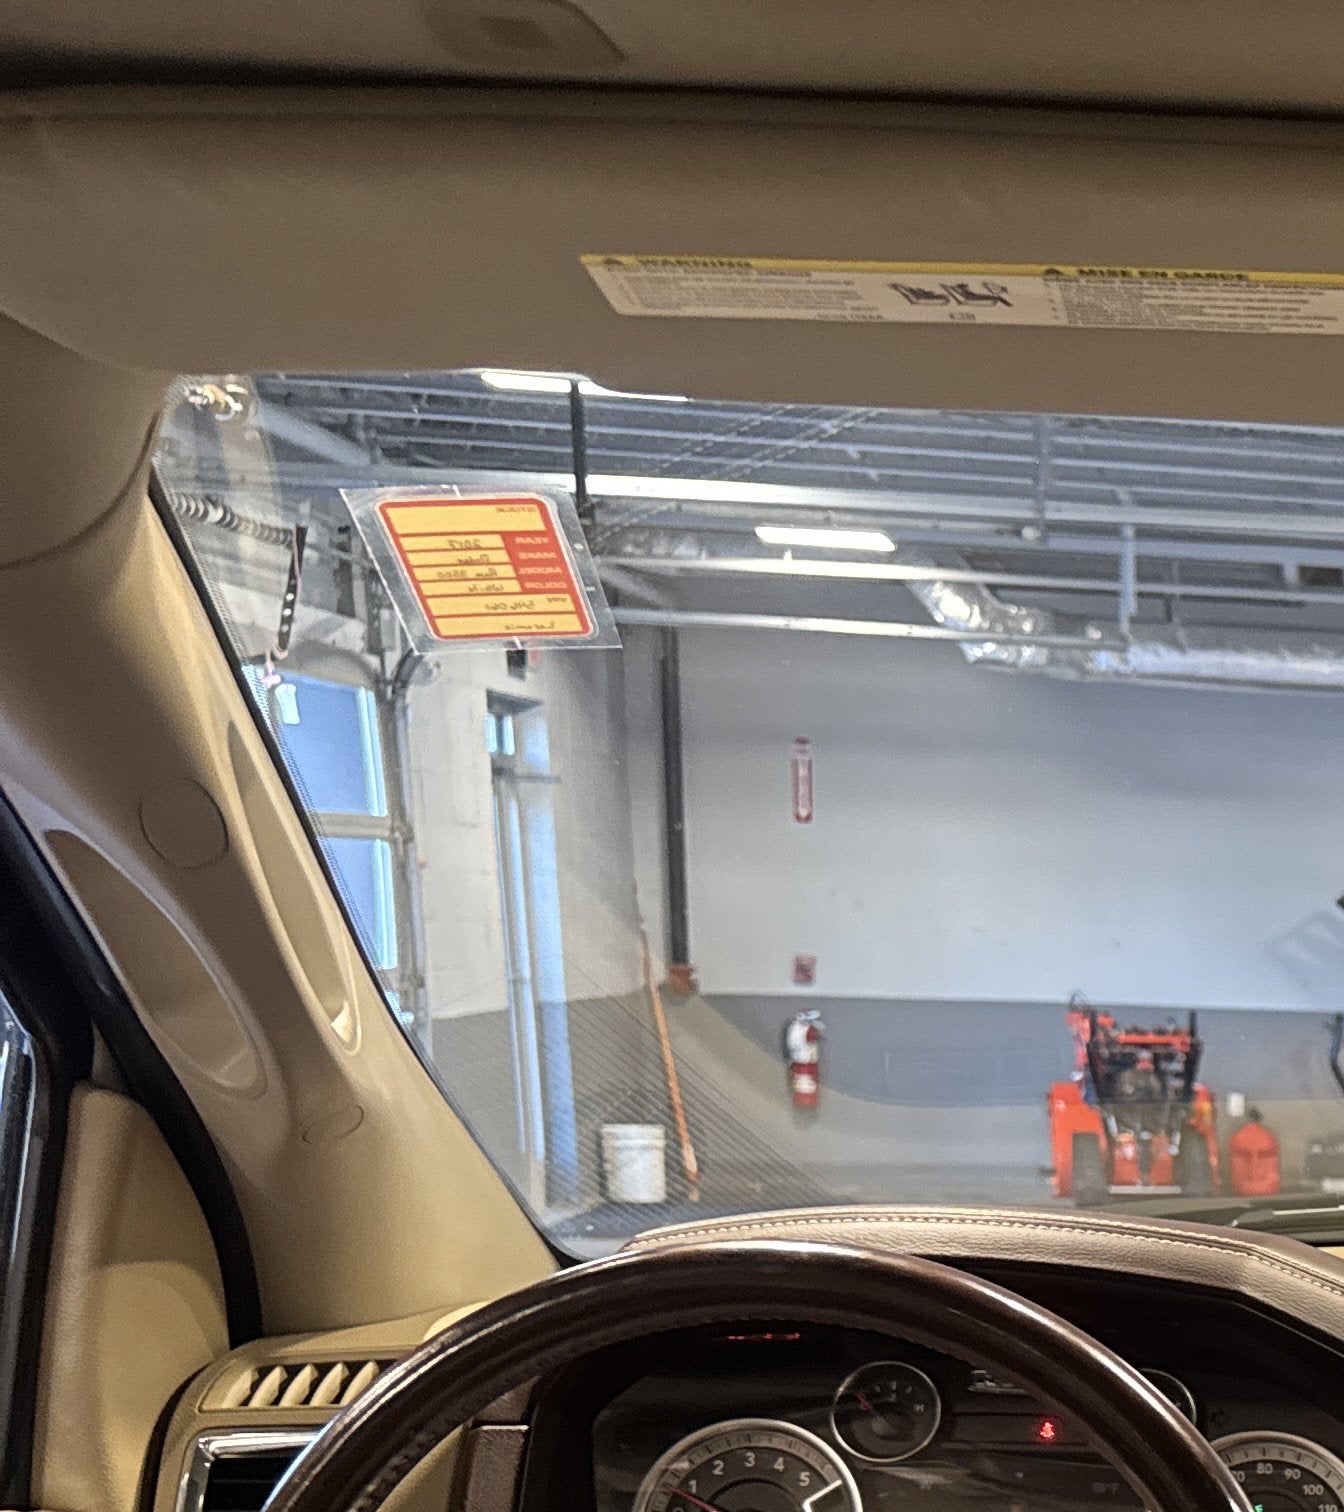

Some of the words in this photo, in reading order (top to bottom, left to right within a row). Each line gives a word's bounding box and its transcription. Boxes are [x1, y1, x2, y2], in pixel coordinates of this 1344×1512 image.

[744, 1452, 756, 1468] 3
[773, 1456, 786, 1472] 4
[712, 1460, 725, 1475] 2
[1256, 1463, 1274, 1475] 80
[1284, 1468, 1302, 1481] 90
[799, 1472, 811, 1487] 5
[688, 1480, 698, 1494] 1
[1302, 1484, 1325, 1496] 100
